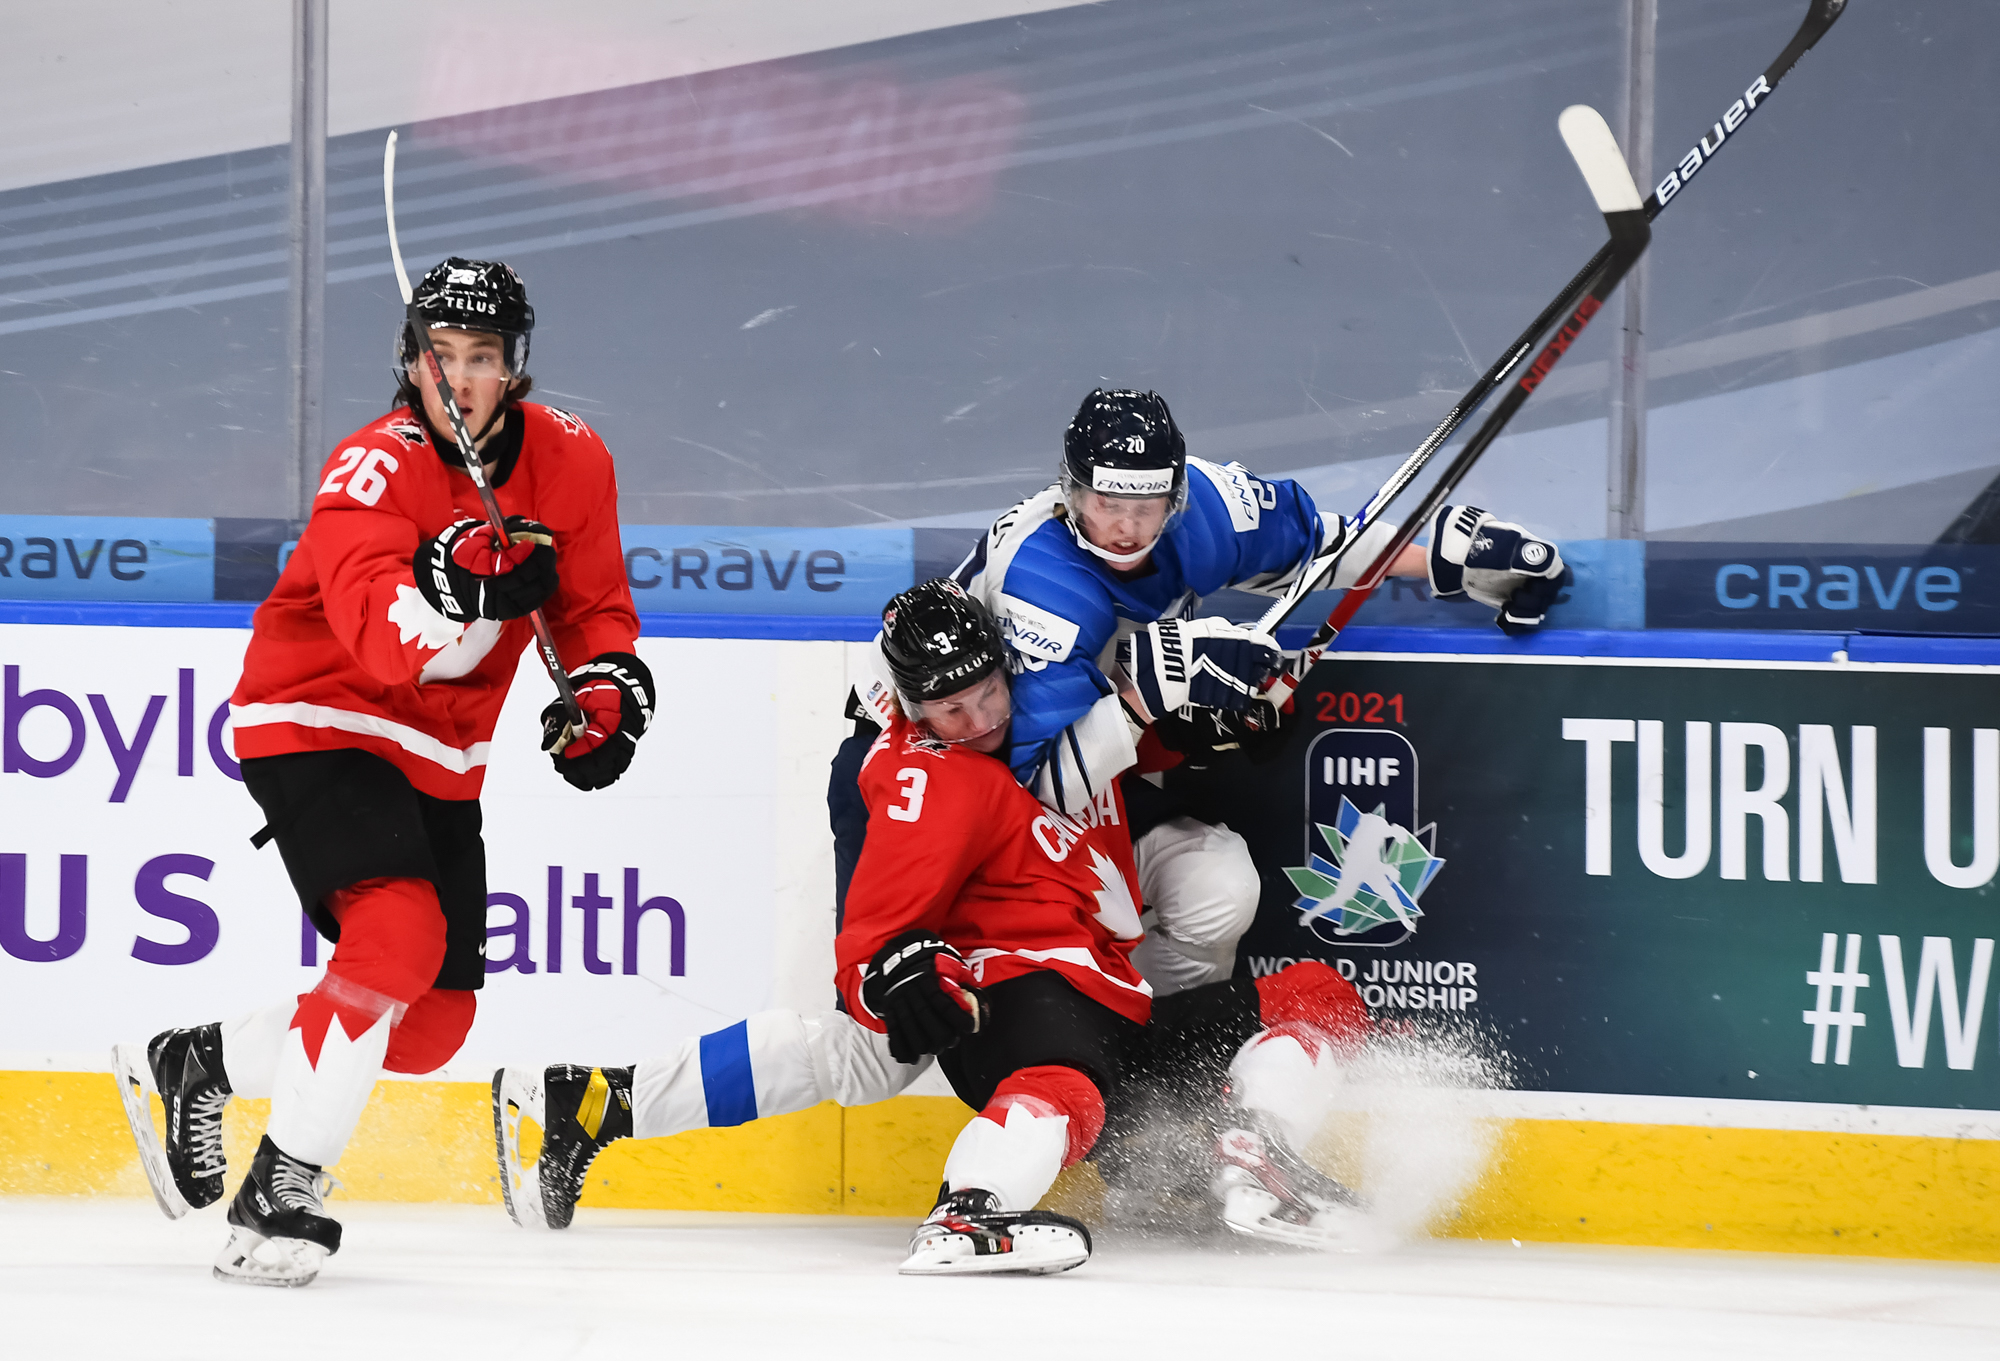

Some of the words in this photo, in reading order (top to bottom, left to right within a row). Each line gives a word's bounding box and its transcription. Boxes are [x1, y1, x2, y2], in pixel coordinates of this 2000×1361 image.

[445, 297, 497, 315] TELUS
[1520, 295, 1602, 394] NEXUS
[1125, 436, 1145, 454] 20
[317, 446, 399, 507] 26
[1097, 479, 1169, 491] FINNAIR
[543, 646, 560, 671] CCM
[933, 632, 954, 655] 3
[945, 651, 989, 681] TELUS
[1316, 691, 1404, 724] 2021
[1323, 757, 1400, 787] IIHF
[887, 767, 929, 823] 3
[1562, 718, 1878, 884] TURN
[1248, 956, 1357, 982] WOD
[1363, 960, 1478, 986] JUNIOR
[173, 1095, 181, 1145] CCM
